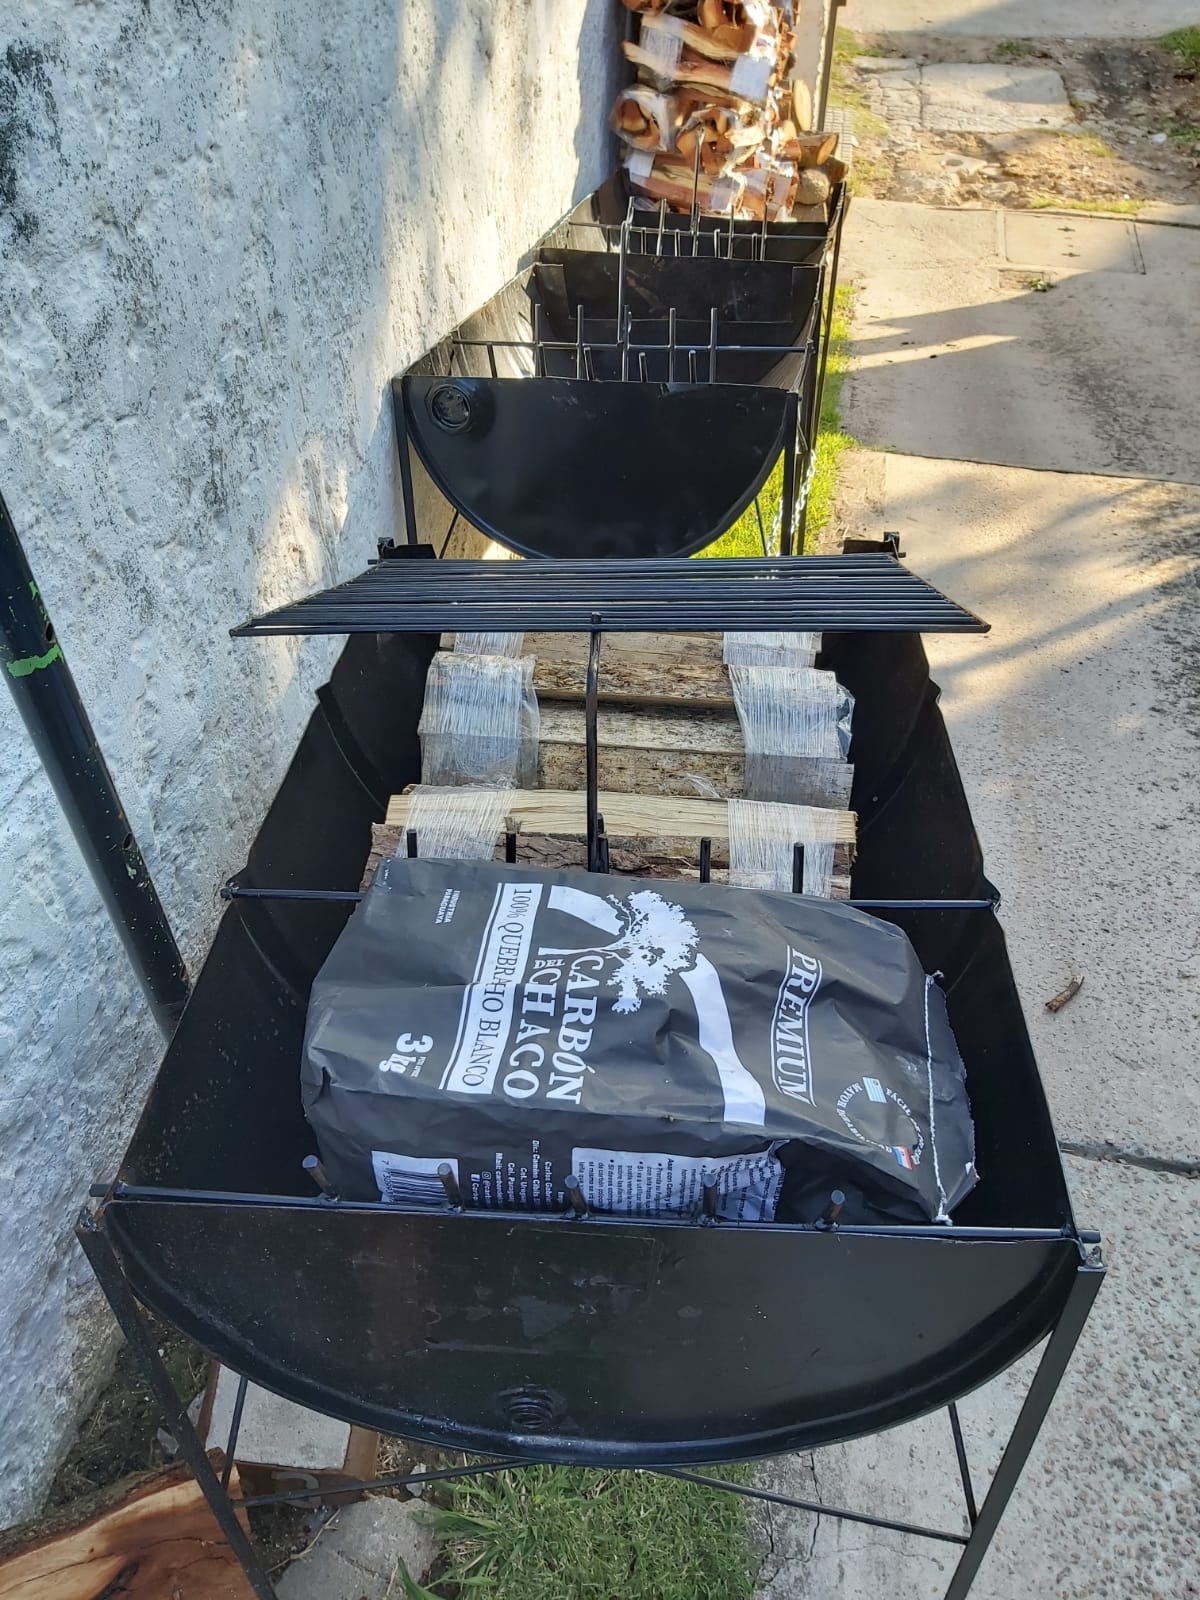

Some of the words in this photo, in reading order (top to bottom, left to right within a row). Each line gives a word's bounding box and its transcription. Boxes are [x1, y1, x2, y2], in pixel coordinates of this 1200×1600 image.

[434, 888, 454, 924] PARAGUAYA
[443, 889, 461, 923] INDUSTRIA
[507, 888, 533, 919] 100%
[481, 921, 525, 1012] QUEBRAHO
[532, 958, 566, 969] DEL
[395, 1032, 434, 1054] 3
[502, 967, 562, 1099] CHACO
[545, 955, 605, 1105] CARBÓN
[774, 948, 818, 1105] PREMIUM
[378, 1053, 418, 1076] kg
[462, 1017, 502, 1087] BLANCO
[836, 1081, 864, 1108] MAYOR
